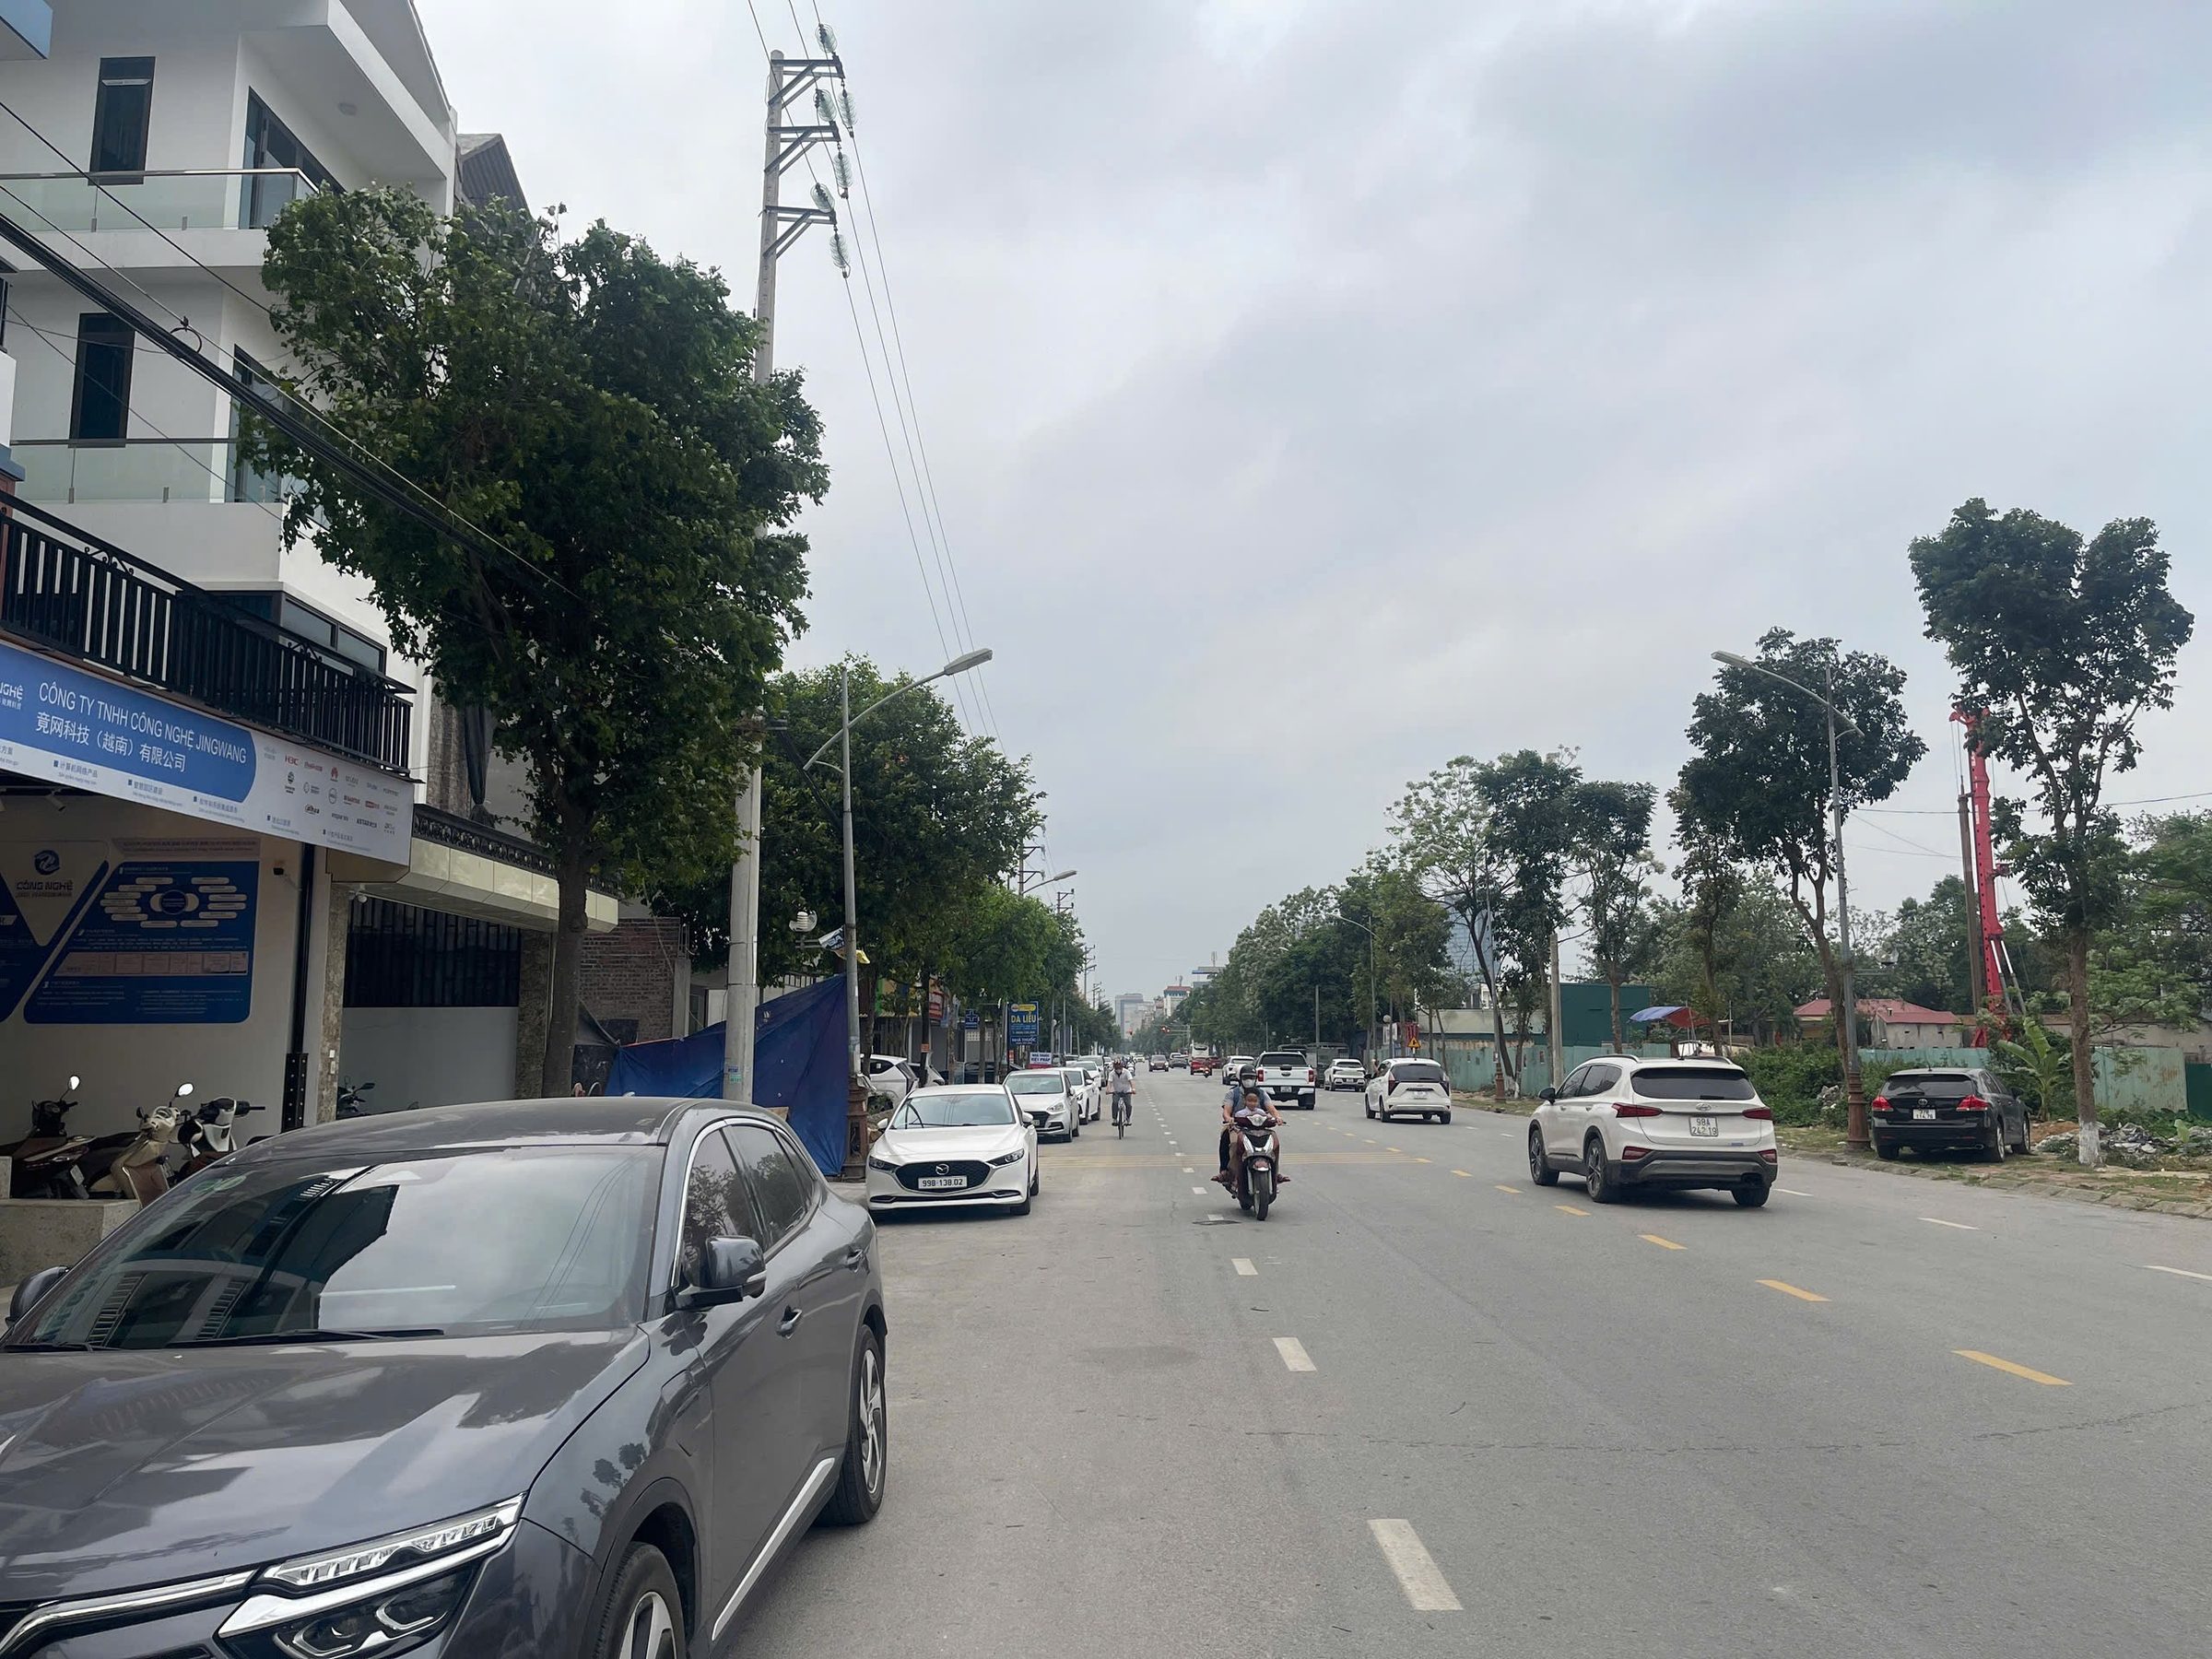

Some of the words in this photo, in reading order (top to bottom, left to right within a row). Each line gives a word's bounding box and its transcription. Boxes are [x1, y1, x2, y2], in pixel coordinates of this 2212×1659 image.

[39, 681, 76, 711] CÔNG
[79, 695, 95, 716] TY
[97, 700, 129, 727] TNHH
[131, 712, 163, 737] CÔNG
[164, 724, 195, 751] NGHỆ
[195, 734, 247, 764] JINGWANG
[284, 754, 300, 767] H3C
[1010, 1015, 1021, 1023] DA
